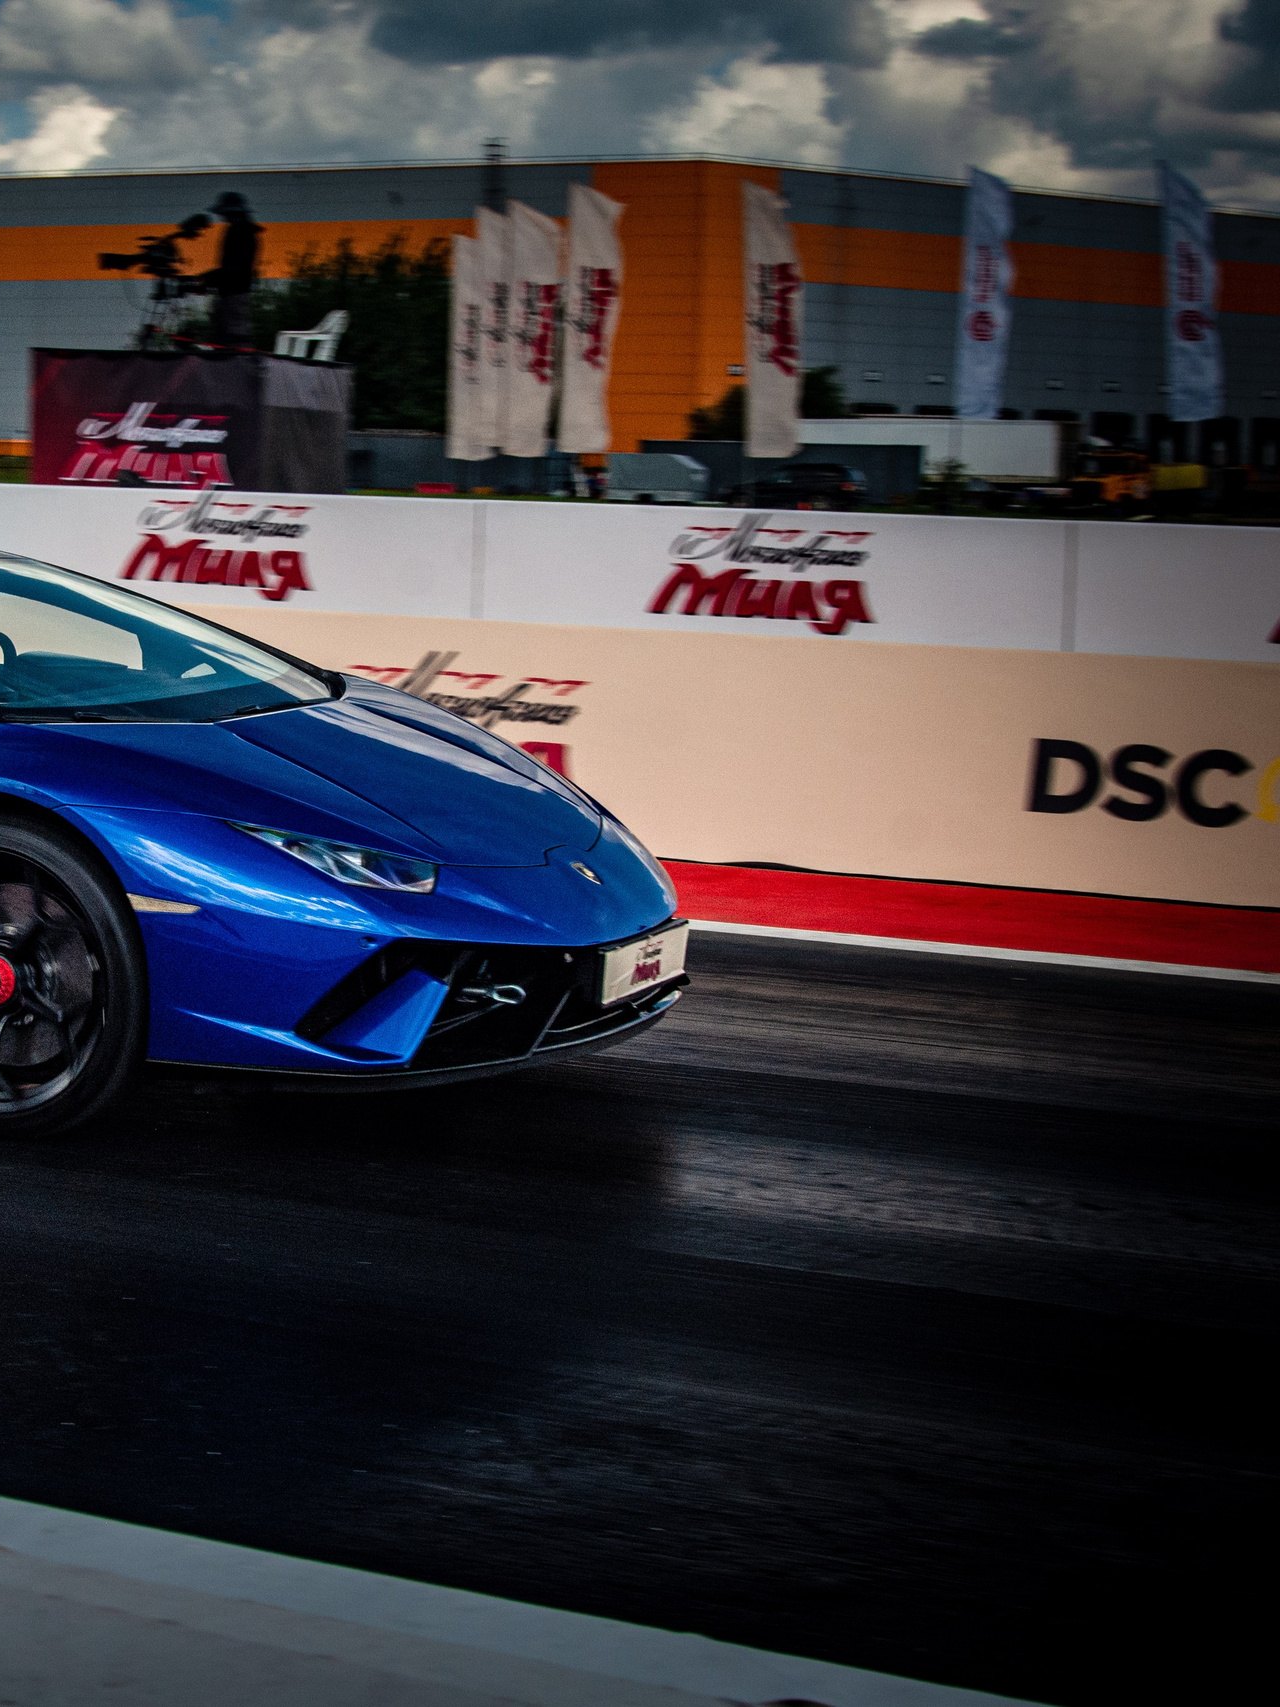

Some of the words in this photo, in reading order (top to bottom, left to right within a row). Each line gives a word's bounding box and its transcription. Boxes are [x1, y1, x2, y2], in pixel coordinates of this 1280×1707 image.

[118, 533, 315, 601] Миля
[644, 562, 879, 635] Миля
[1023, 738, 1256, 828] DSC
